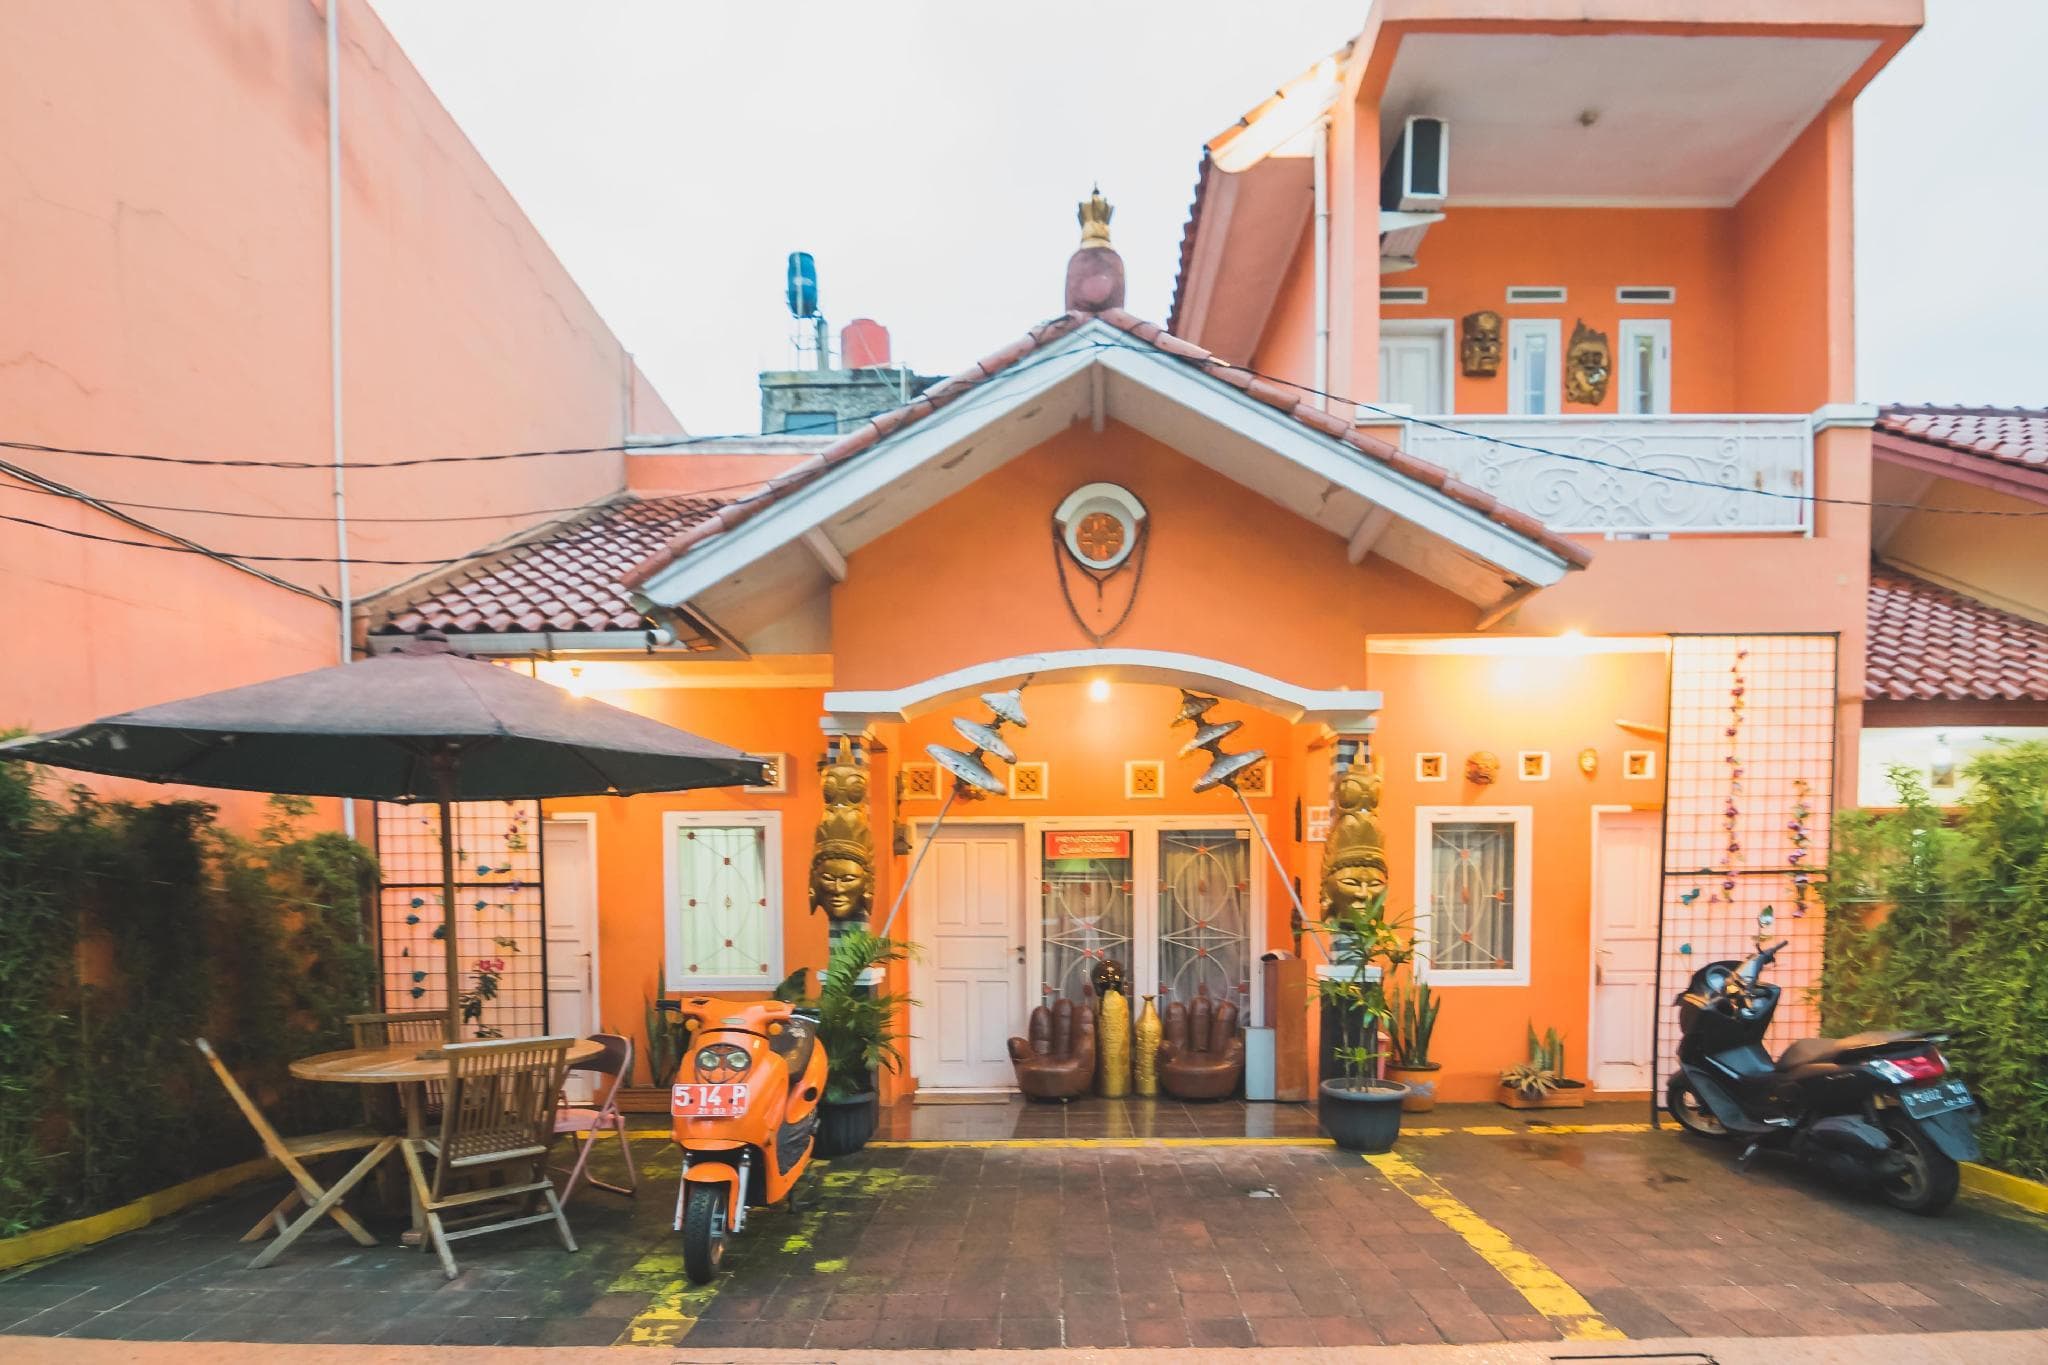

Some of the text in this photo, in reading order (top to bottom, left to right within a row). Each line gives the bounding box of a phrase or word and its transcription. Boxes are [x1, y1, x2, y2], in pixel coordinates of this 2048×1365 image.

[675, 1085, 747, 1107] 5 14 P
